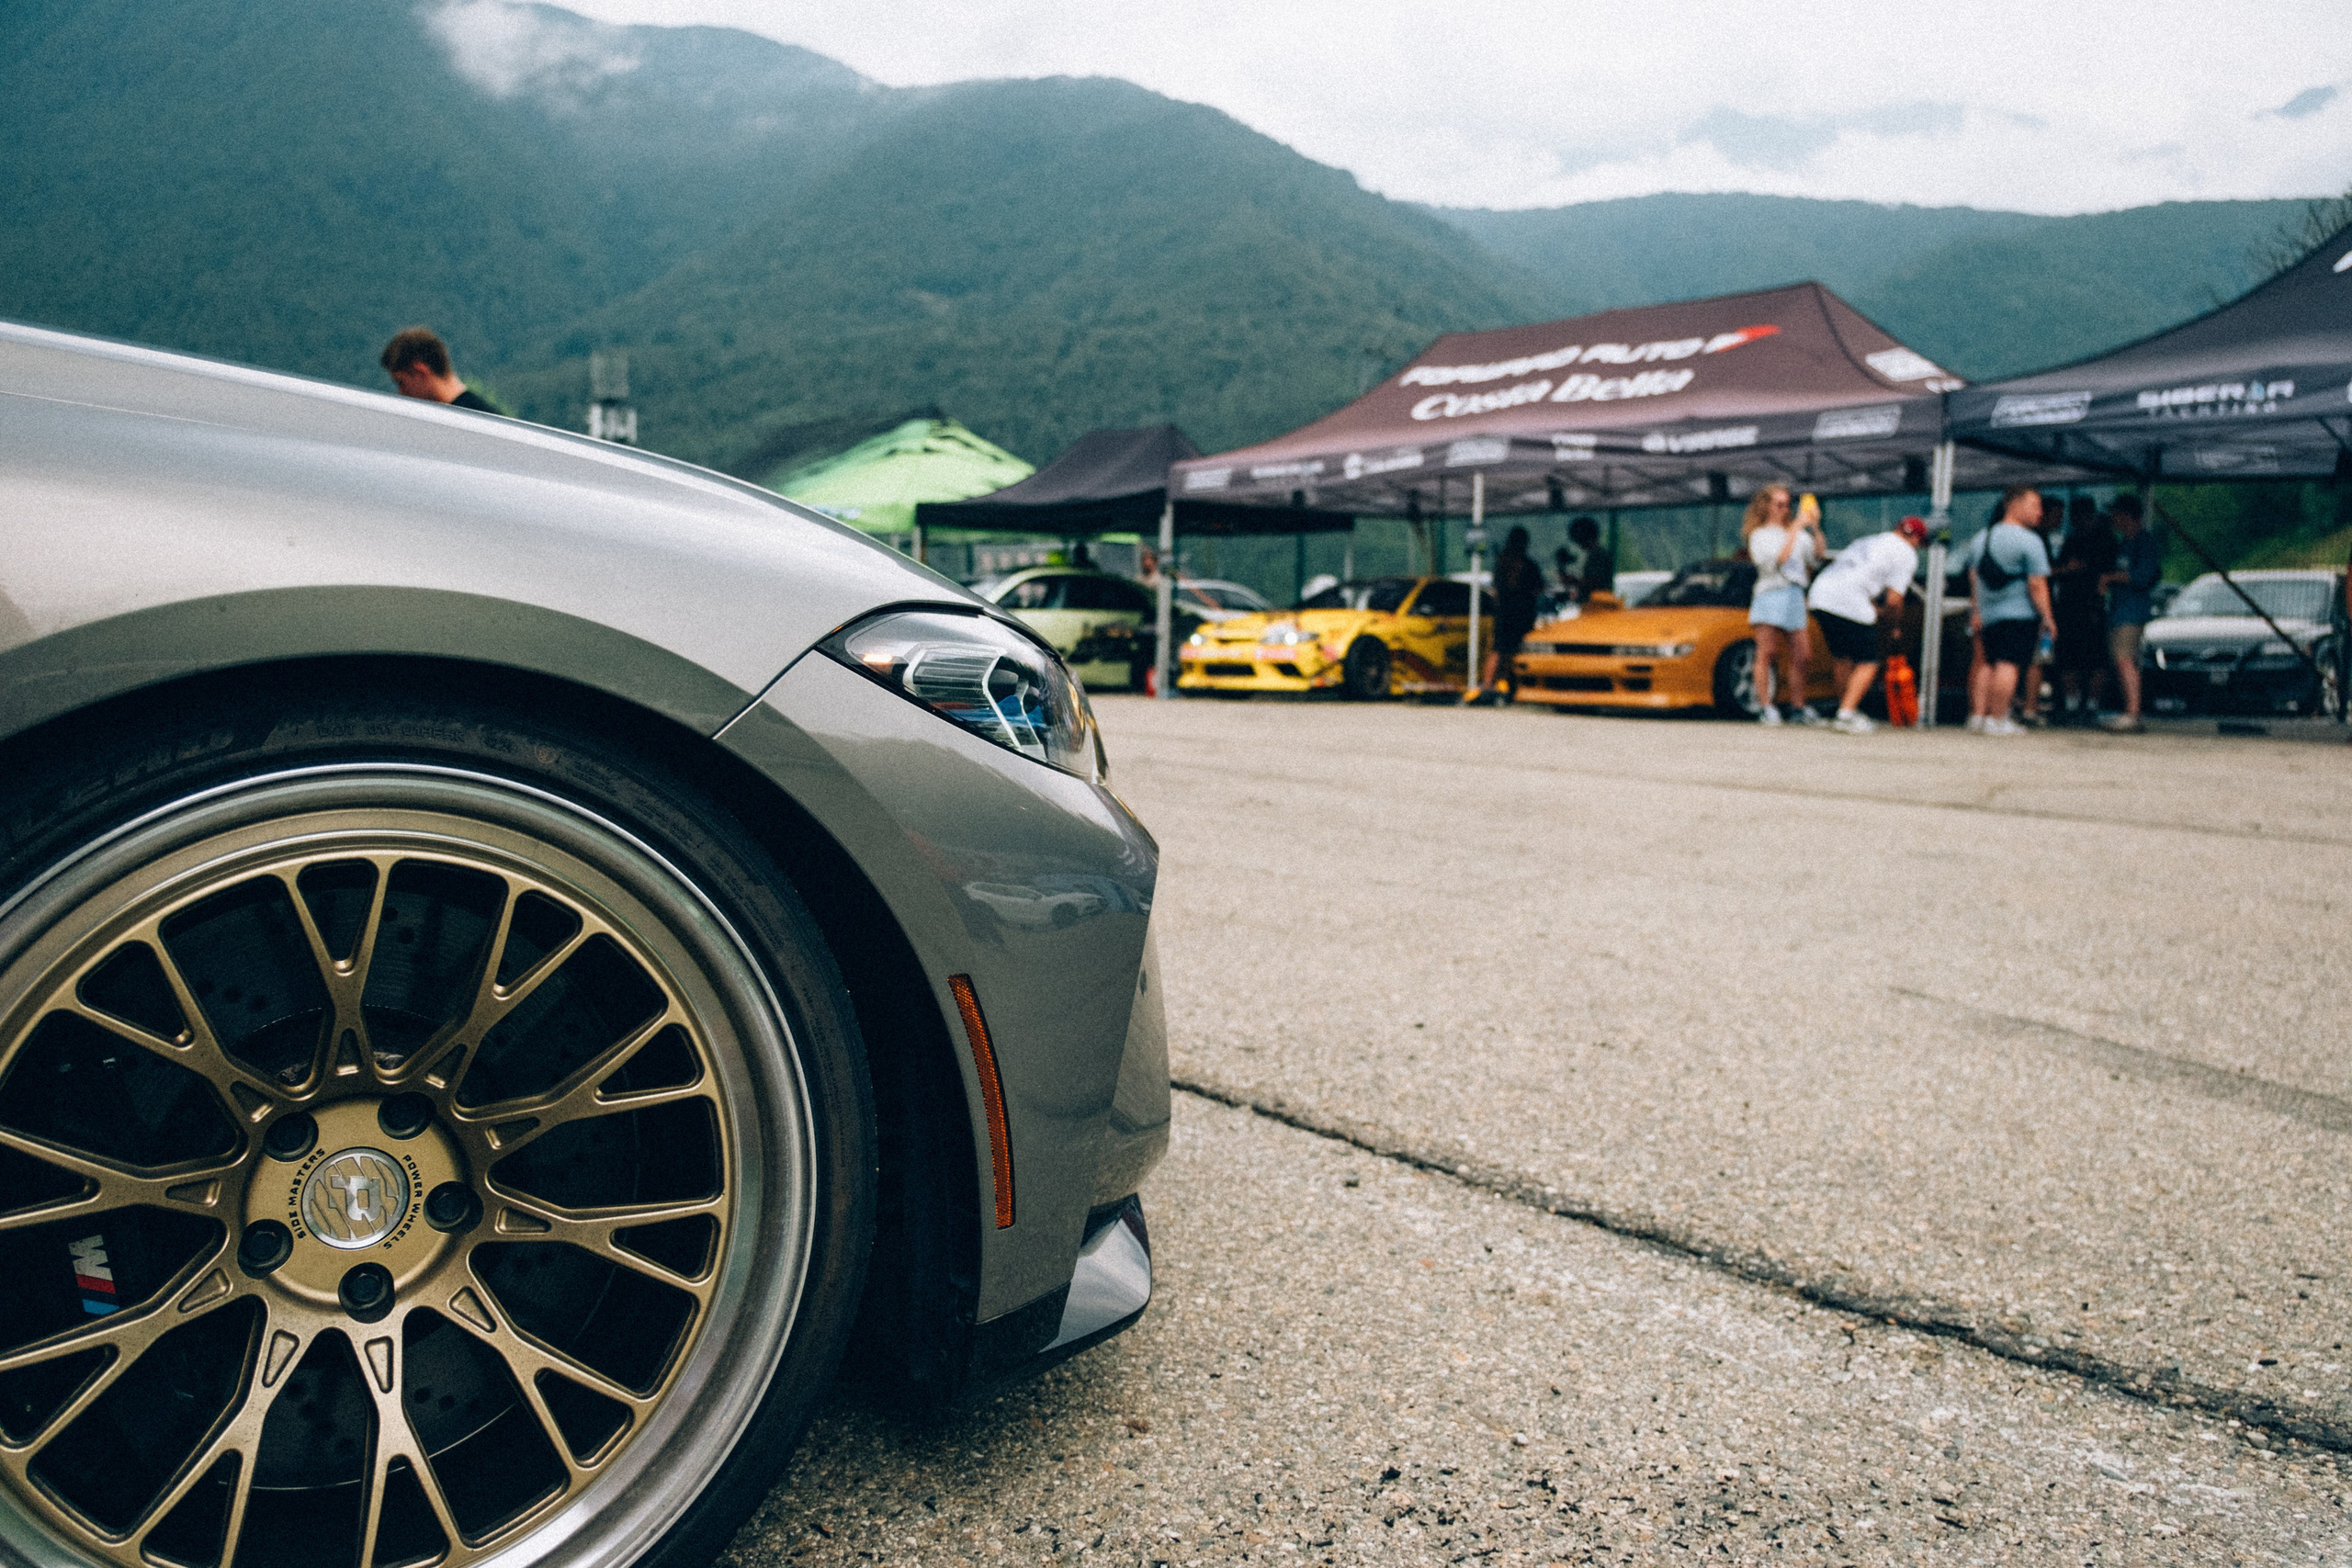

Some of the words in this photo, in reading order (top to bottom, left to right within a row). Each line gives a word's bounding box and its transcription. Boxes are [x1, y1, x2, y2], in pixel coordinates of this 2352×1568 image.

[288, 1147, 325, 1206] MASTERS
[402, 1154, 423, 1198] POWER
[288, 1210, 306, 1239] SIDE
[383, 1202, 422, 1250] WHEELS
